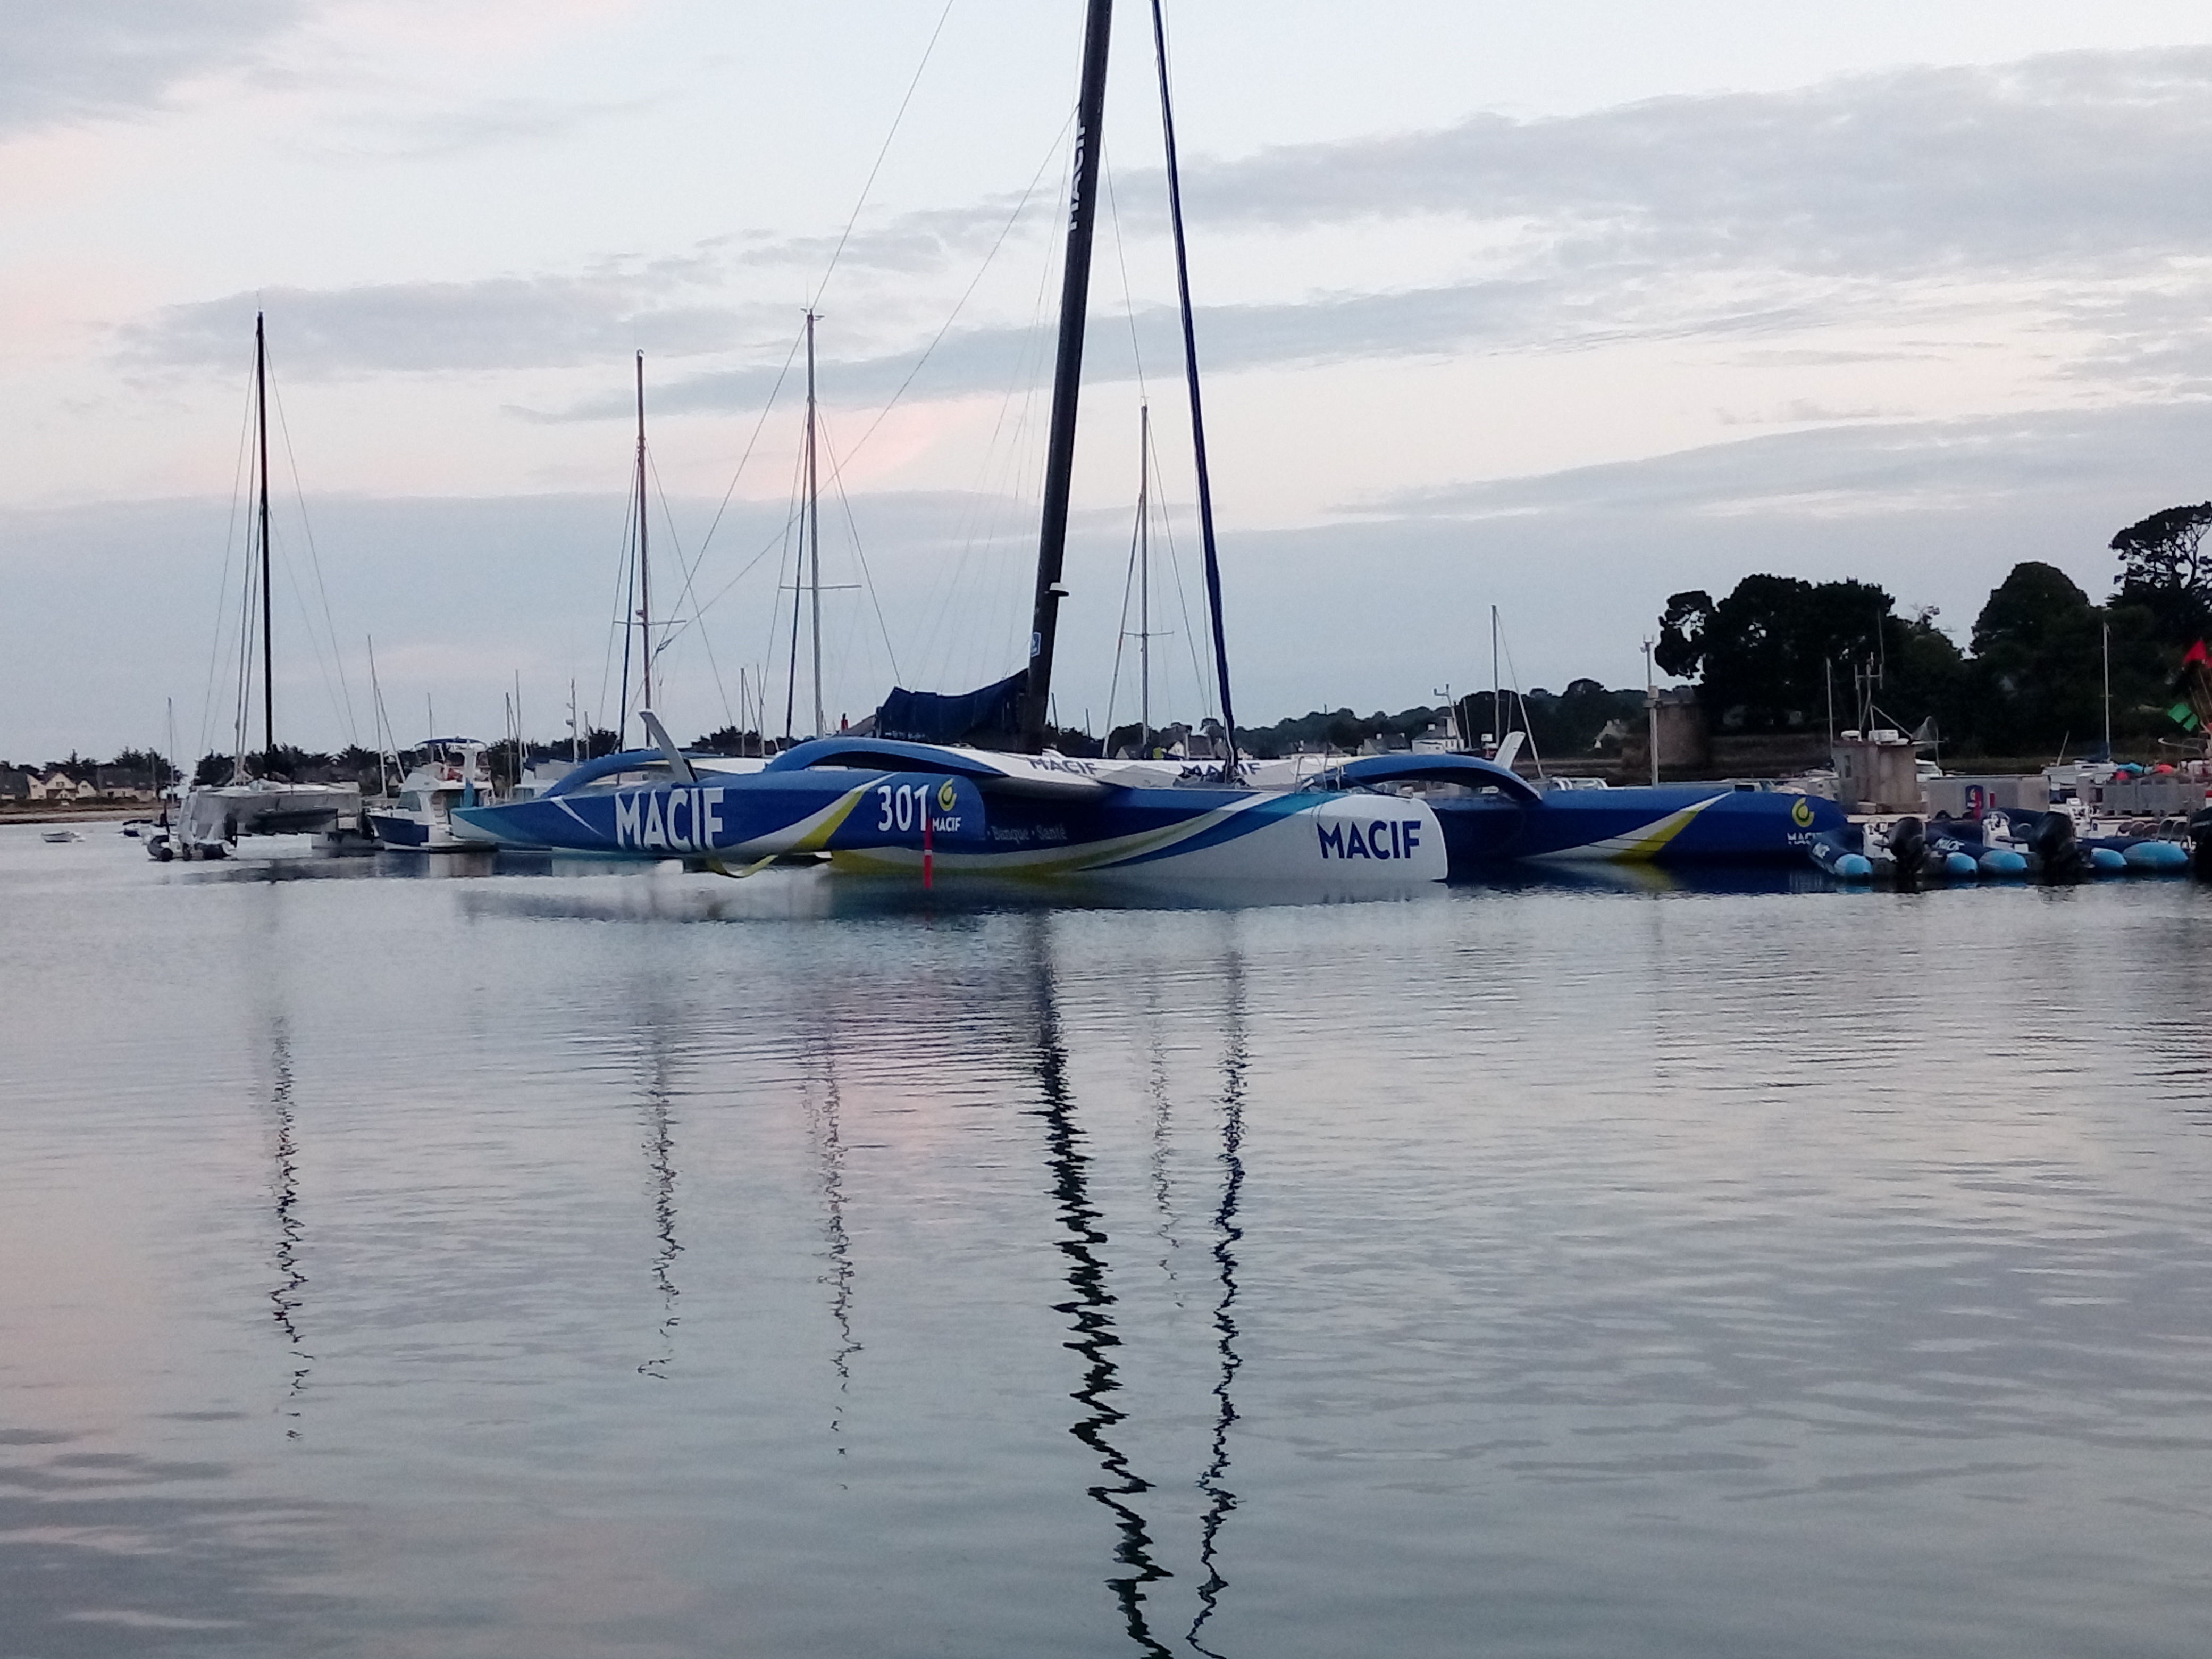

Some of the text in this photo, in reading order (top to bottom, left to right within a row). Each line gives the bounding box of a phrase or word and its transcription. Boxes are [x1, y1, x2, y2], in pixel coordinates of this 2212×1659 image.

[1027, 758, 1097, 775] MACIF
[1180, 763, 1261, 776] MAIF
[615, 787, 724, 851] MACIF
[878, 784, 930, 831] 301
[932, 817, 961, 832] MACIF
[1317, 820, 1421, 859] MACIF
